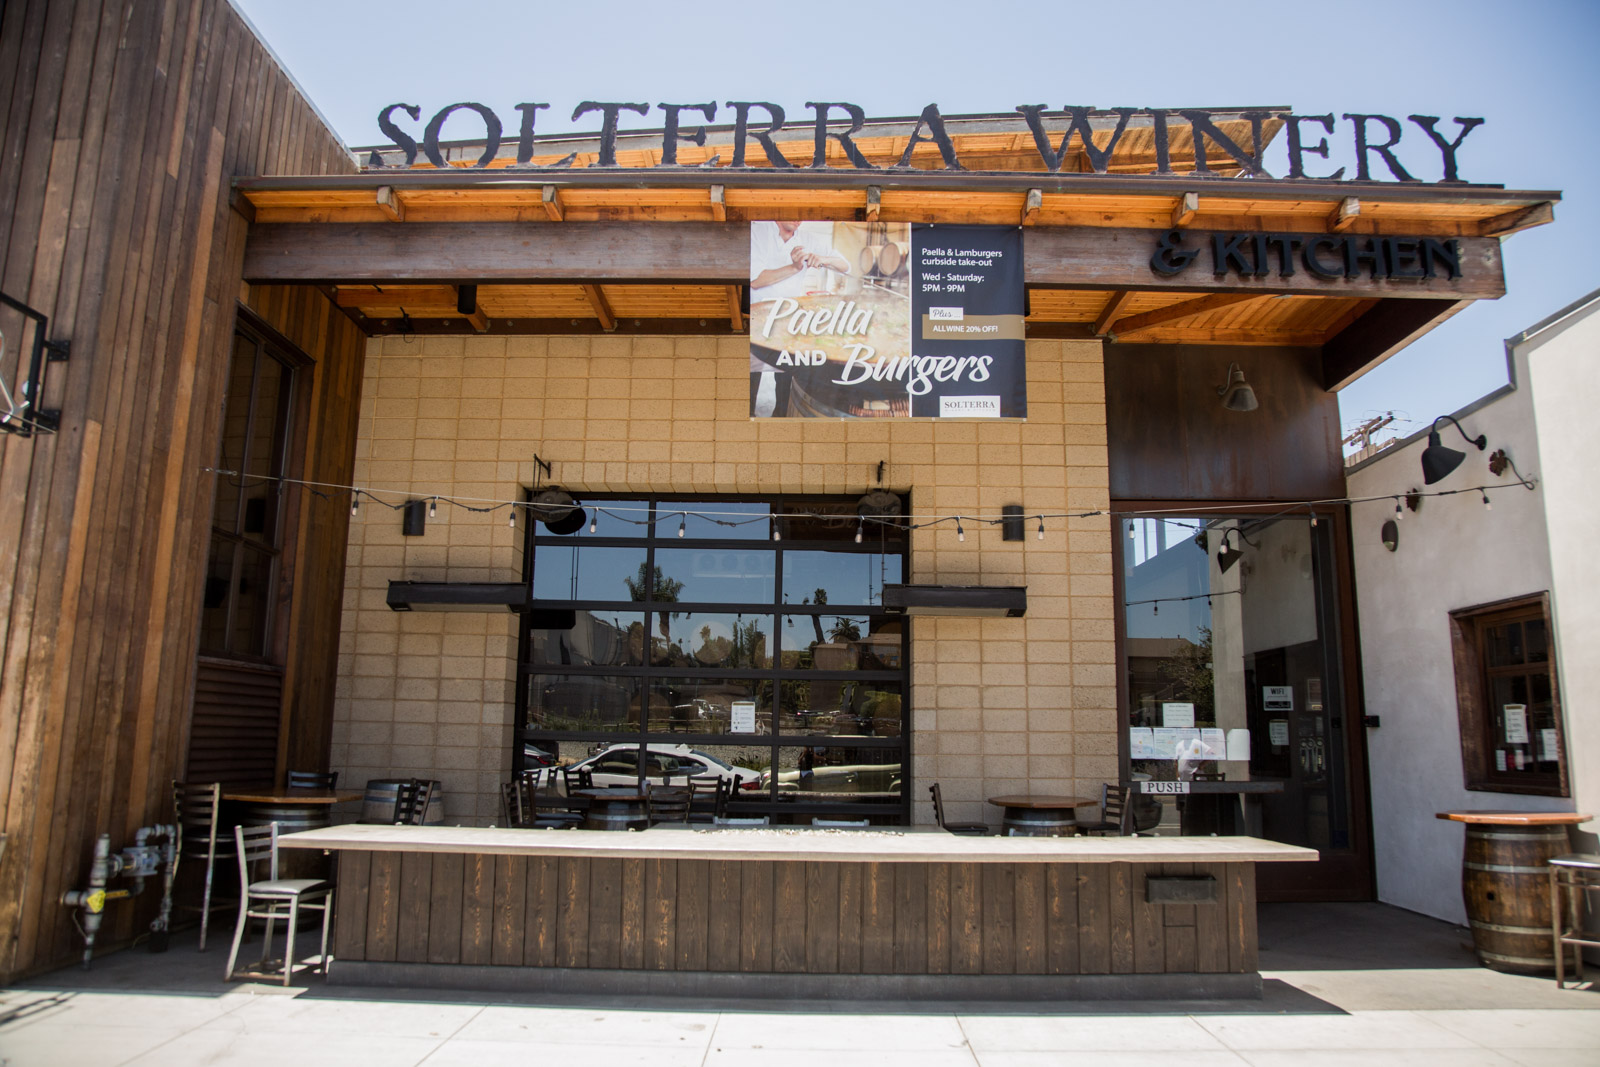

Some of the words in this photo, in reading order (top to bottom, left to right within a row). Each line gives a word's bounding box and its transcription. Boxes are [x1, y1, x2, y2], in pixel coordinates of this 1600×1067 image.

[368, 100, 967, 170] SOLTERRA
[1016, 103, 1485, 184] WINERY
[922, 248, 946, 256] Paella
[955, 248, 1002, 258] Lamburgers
[1150, 229, 1201, 278] &
[1210, 232, 1463, 281] KITCHEN
[922, 258, 956, 266] curbside
[958, 258, 992, 266] take-out
[947, 273, 984, 284] Saturday:
[922, 284, 940, 292] 5PM
[946, 284, 966, 292] 9PM
[761, 297, 874, 339] Paella
[932, 308, 952, 318] Plus
[932, 324, 946, 332] ALL
[946, 324, 965, 333] WINE
[965, 325, 981, 333] 20%
[981, 325, 999, 333] OFF!
[775, 349, 828, 367] AND
[831, 342, 994, 396] Burgers
[944, 400, 996, 409] SOLTERRA
[1146, 782, 1184, 793] PUSH
